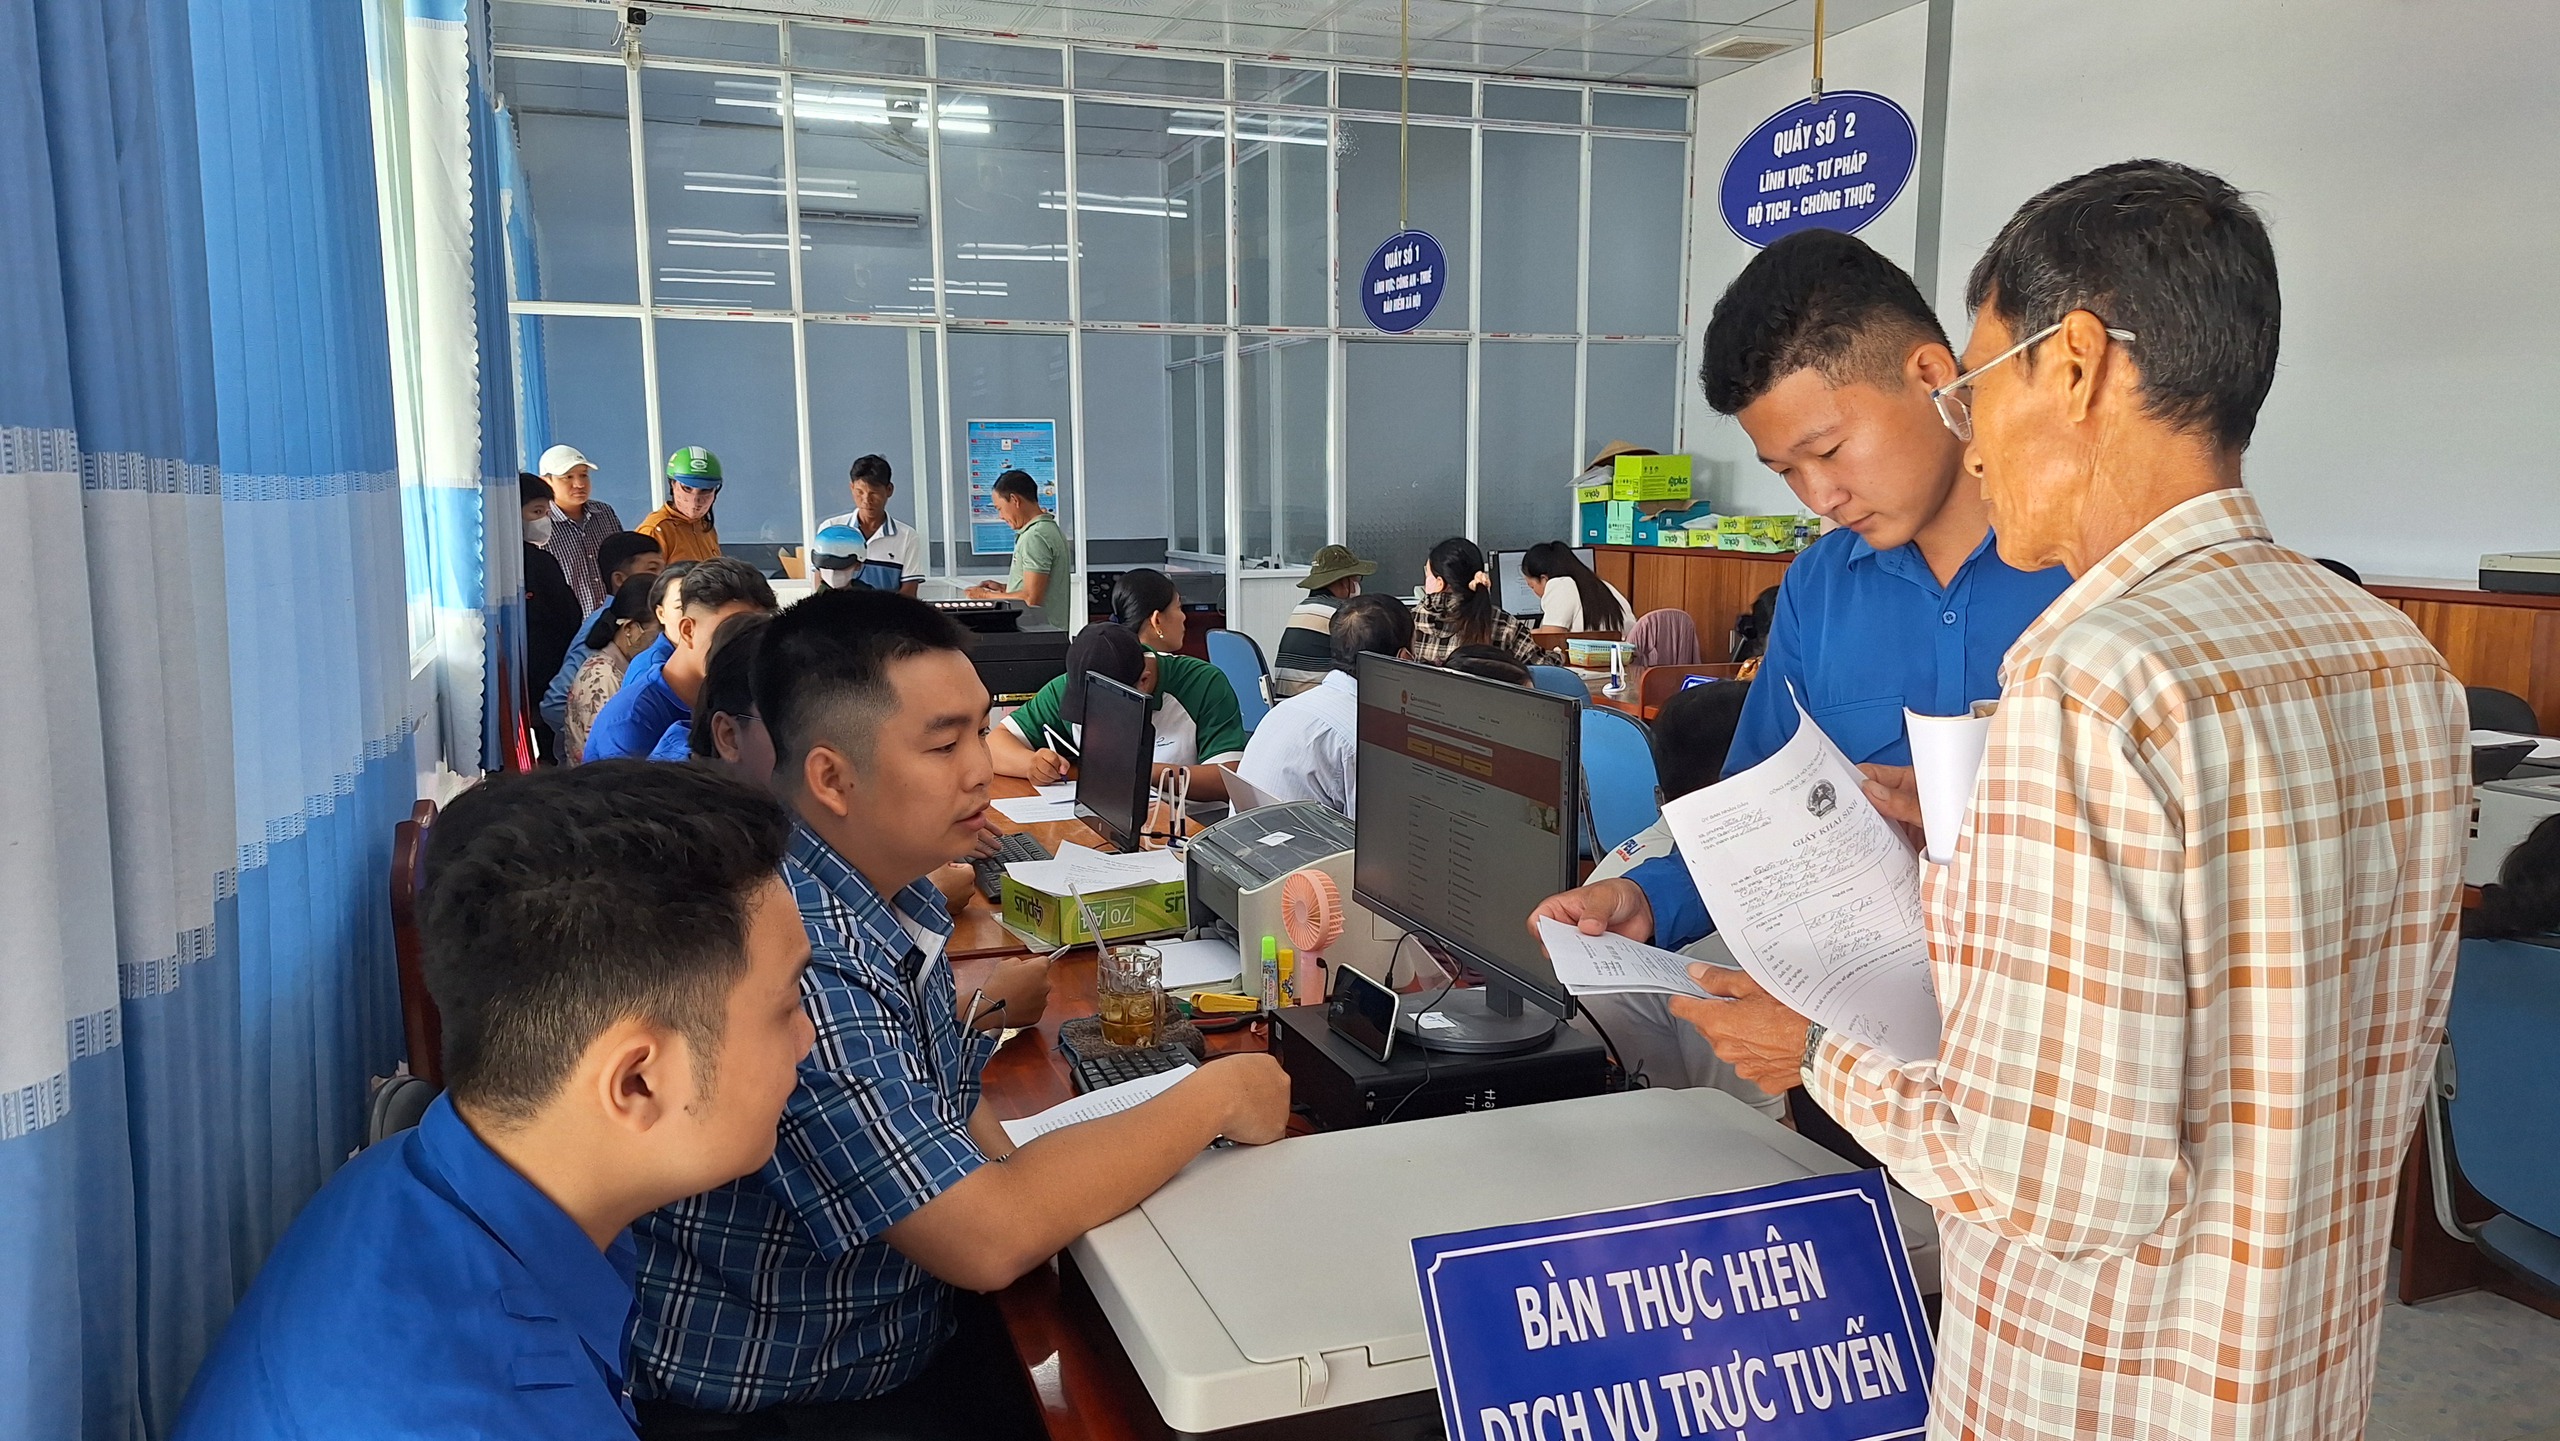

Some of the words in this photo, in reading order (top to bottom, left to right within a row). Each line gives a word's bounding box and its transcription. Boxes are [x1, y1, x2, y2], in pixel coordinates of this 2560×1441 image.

[1773, 118, 1812, 158] QUẦY
[1814, 109, 1837, 147] SỐ
[1844, 112, 1857, 139] 2
[1758, 169, 1786, 193] LĨNH
[1787, 164, 1814, 190] VỰC:
[1816, 157, 1834, 182] TƯ
[1833, 149, 1868, 178] PHÁP
[1746, 201, 1764, 229] HỘ
[1765, 199, 1792, 227] TỊCH
[1799, 189, 1842, 217] CHỨNG
[1843, 181, 1877, 210] THỰC
[1403, 241, 1413, 265] SỐ
[1415, 244, 1420, 262] 1
[1792, 831, 1818, 848] GIẤY
[1819, 816, 1843, 836] KHAI
[1842, 799, 1859, 820] SINH
[1110, 905, 1132, 924] 70
[1515, 1260, 1607, 1351] BÀN
[1606, 1249, 1723, 1341] THỰC
[1722, 1225, 1828, 1322] HIỆN
[1659, 1349, 1774, 1441] TRỰC
[1772, 1315, 1908, 1414] TUYẾN
